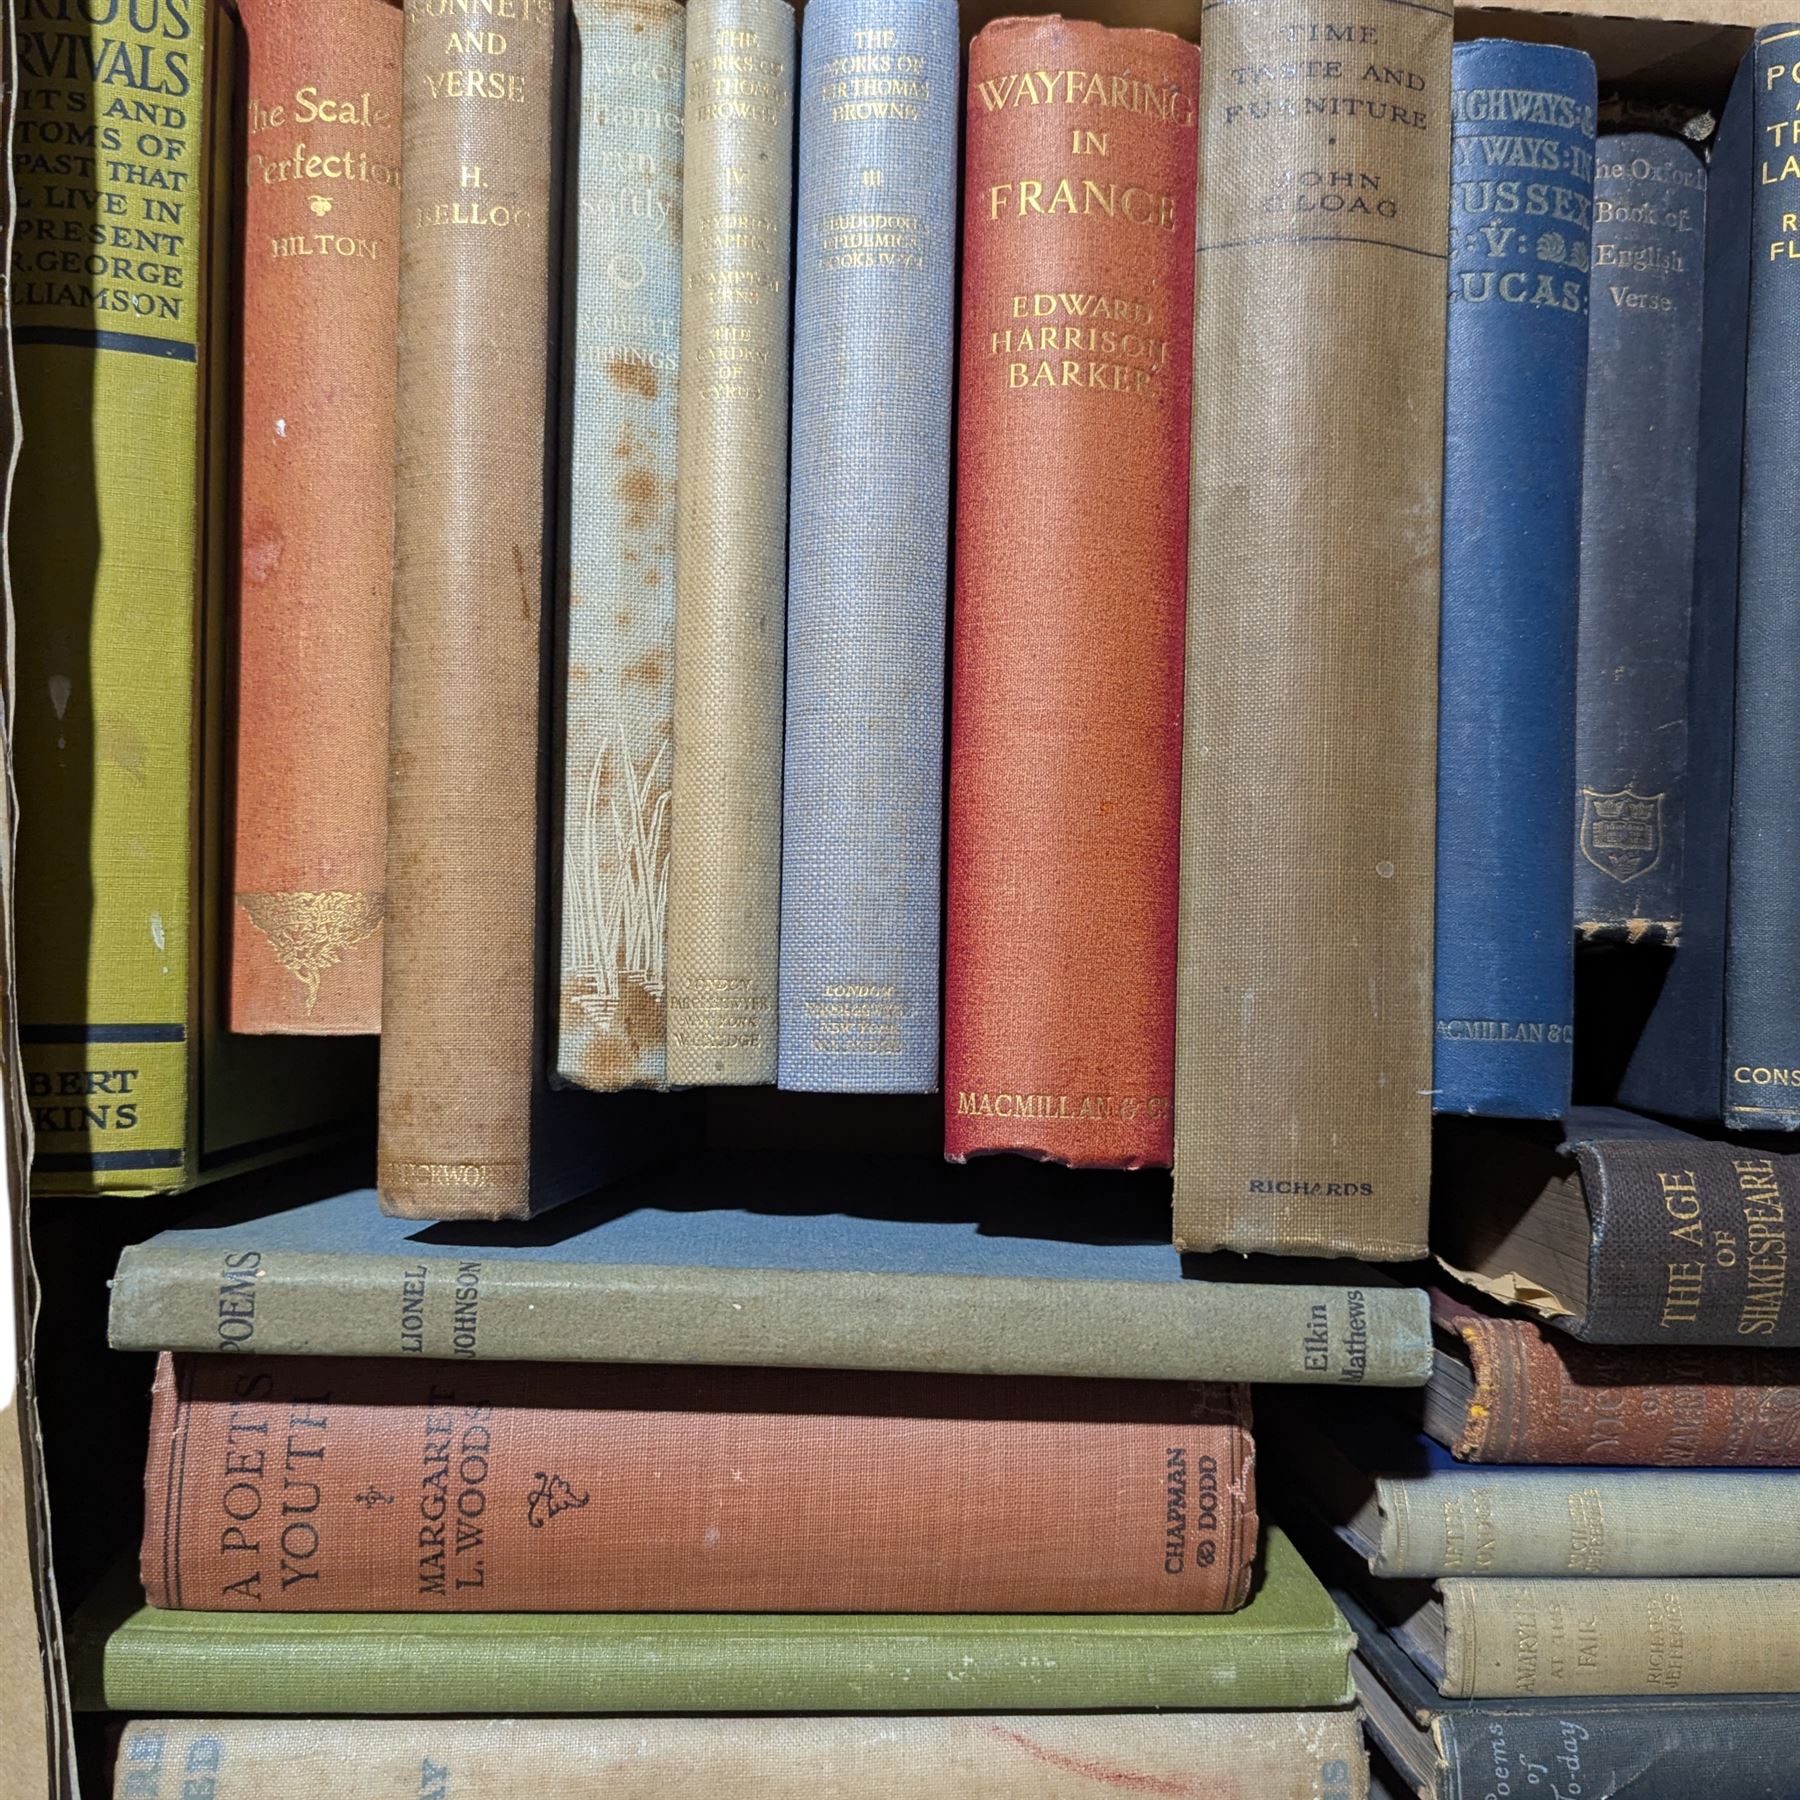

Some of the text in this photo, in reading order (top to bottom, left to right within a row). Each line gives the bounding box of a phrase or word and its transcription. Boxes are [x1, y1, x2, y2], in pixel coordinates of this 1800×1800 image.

[447, 31, 507, 55] AND
[855, 30, 898, 50] THE
[1284, 24, 1378, 45] TIME
[424, 71, 526, 103] VERSE
[1364, 65, 1426, 92] AND
[22, 88, 188, 130] ITS AND
[978, 69, 1195, 128] WAYFARING
[137, 133, 188, 163] OF
[1071, 129, 1108, 156] IN
[106, 159, 189, 193] THAT
[461, 165, 488, 189] H.
[43, 186, 127, 217] LIVE
[142, 199, 184, 225] IN
[1595, 201, 1657, 225] Book
[271, 233, 378, 261] HILTON
[1595, 244, 1685, 273] English
[1012, 293, 1153, 326] EDWARD
[1009, 360, 1154, 396] BARKER
[28, 1069, 139, 1096] BERT
[31, 1103, 138, 1132] KINS
[1248, 1178, 1374, 1198] RICHARDS
[1657, 1169, 1704, 1248] AGE
[1712, 1230, 1737, 1268] OF
[1732, 1157, 1788, 1337] SHAKESPEARE
[401, 1264, 428, 1354] LIONEL
[453, 1260, 482, 1359] JOHNSON
[1660, 1262, 1705, 1328] THE
[1304, 1303, 1328, 1373] Elkin
[1339, 1288, 1368, 1384] Mathews
[280, 1391, 332, 1592] YOUTH
[417, 1385, 457, 1597] MARGARET
[1197, 1455, 1220, 1533] DODD
[1164, 1448, 1188, 1576] CHAPMAN
[221, 1570, 262, 1602] A
[1519, 1753, 1548, 1785] of
